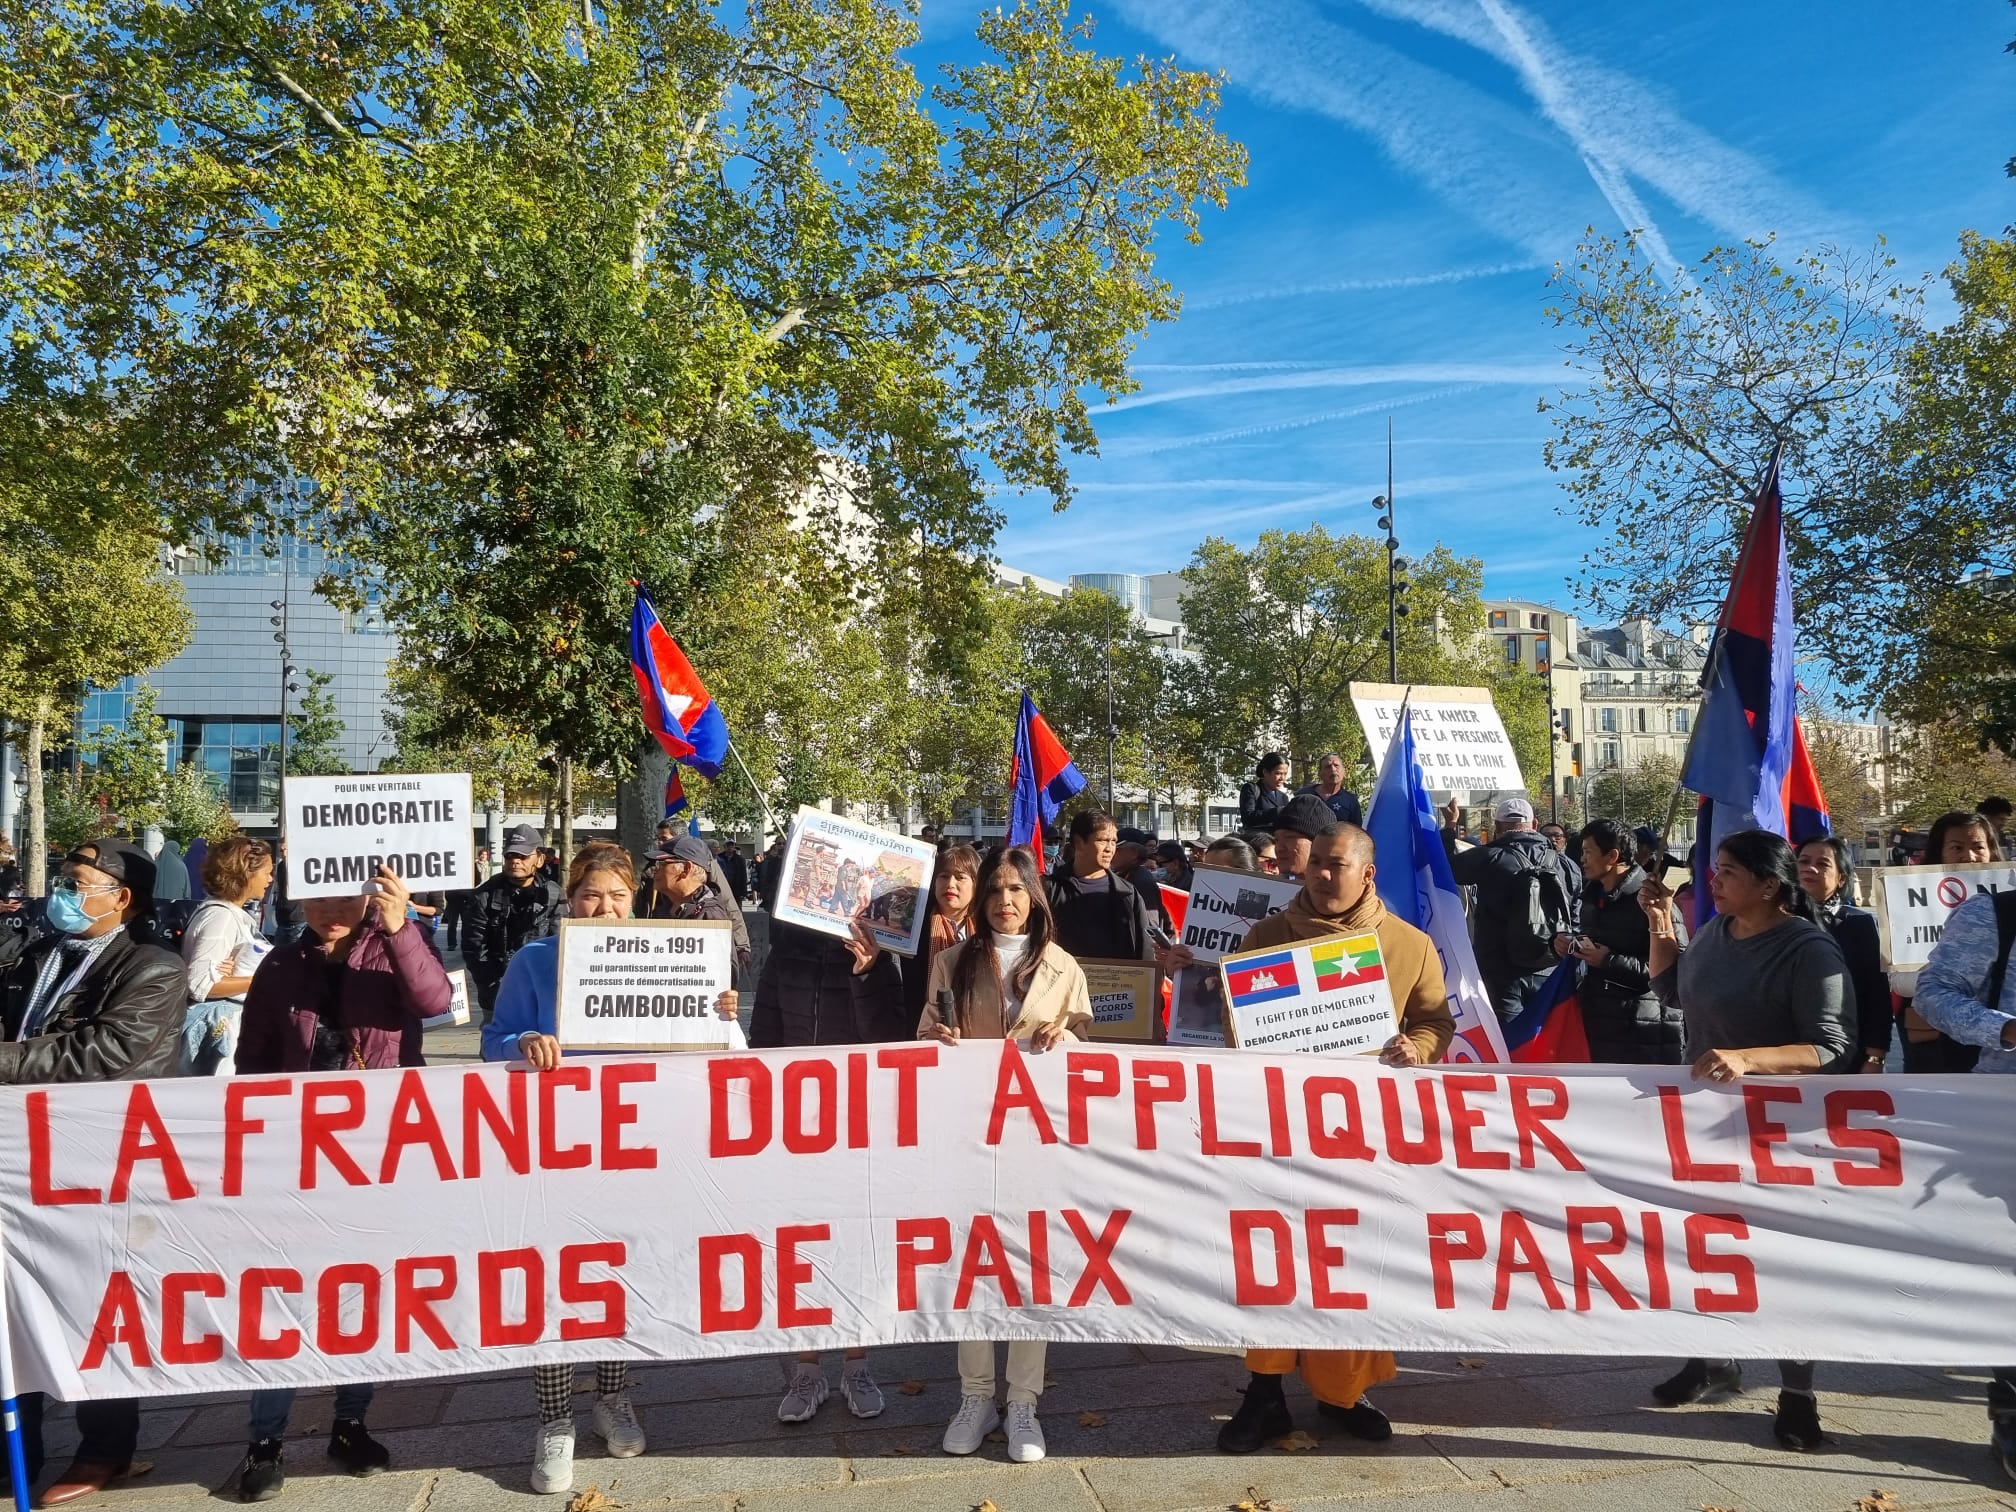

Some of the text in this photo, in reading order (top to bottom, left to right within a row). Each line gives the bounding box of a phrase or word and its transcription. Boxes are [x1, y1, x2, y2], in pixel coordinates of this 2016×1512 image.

[1375, 707, 1389, 720] LE
[1438, 709, 1480, 723] KHMER
[1378, 726, 1432, 742] RETE
[1433, 729, 1448, 742] LA
[1435, 752, 1452, 767] DE
[1455, 753, 1471, 768] LA
[1473, 754, 1506, 769] CHINE
[334, 781, 421, 793] POUR UNE VERITABLE
[1442, 775, 1500, 790] CAMBODGE
[302, 799, 454, 828] DEMOCRATIE
[303, 851, 457, 885] CAMBODGE
[593, 936, 704, 954] de Paris de 1991
[590, 964, 603, 973] qui
[604, 964, 657, 973] garantissent
[658, 965, 669, 973] un
[579, 978, 623, 987] processus
[624, 977, 635, 986] de
[584, 994, 708, 1019] CAMBODGE
[1092, 1002, 1134, 1013] CCORDS
[1256, 993, 1376, 1027] FIGHT FOR DEMOCRACY
[1094, 1013, 1124, 1023] PARIS
[1244, 1011, 1391, 1048] DEMOCRATIE AU CAMBODGE
[1313, 1035, 1365, 1053] BIRMANIE
[27, 1039, 1903, 1205] LA FRANCE DOIT APPLIQUER LES
[80, 1206, 1758, 1369] ACCORDS DE PAIX DE PARIS
